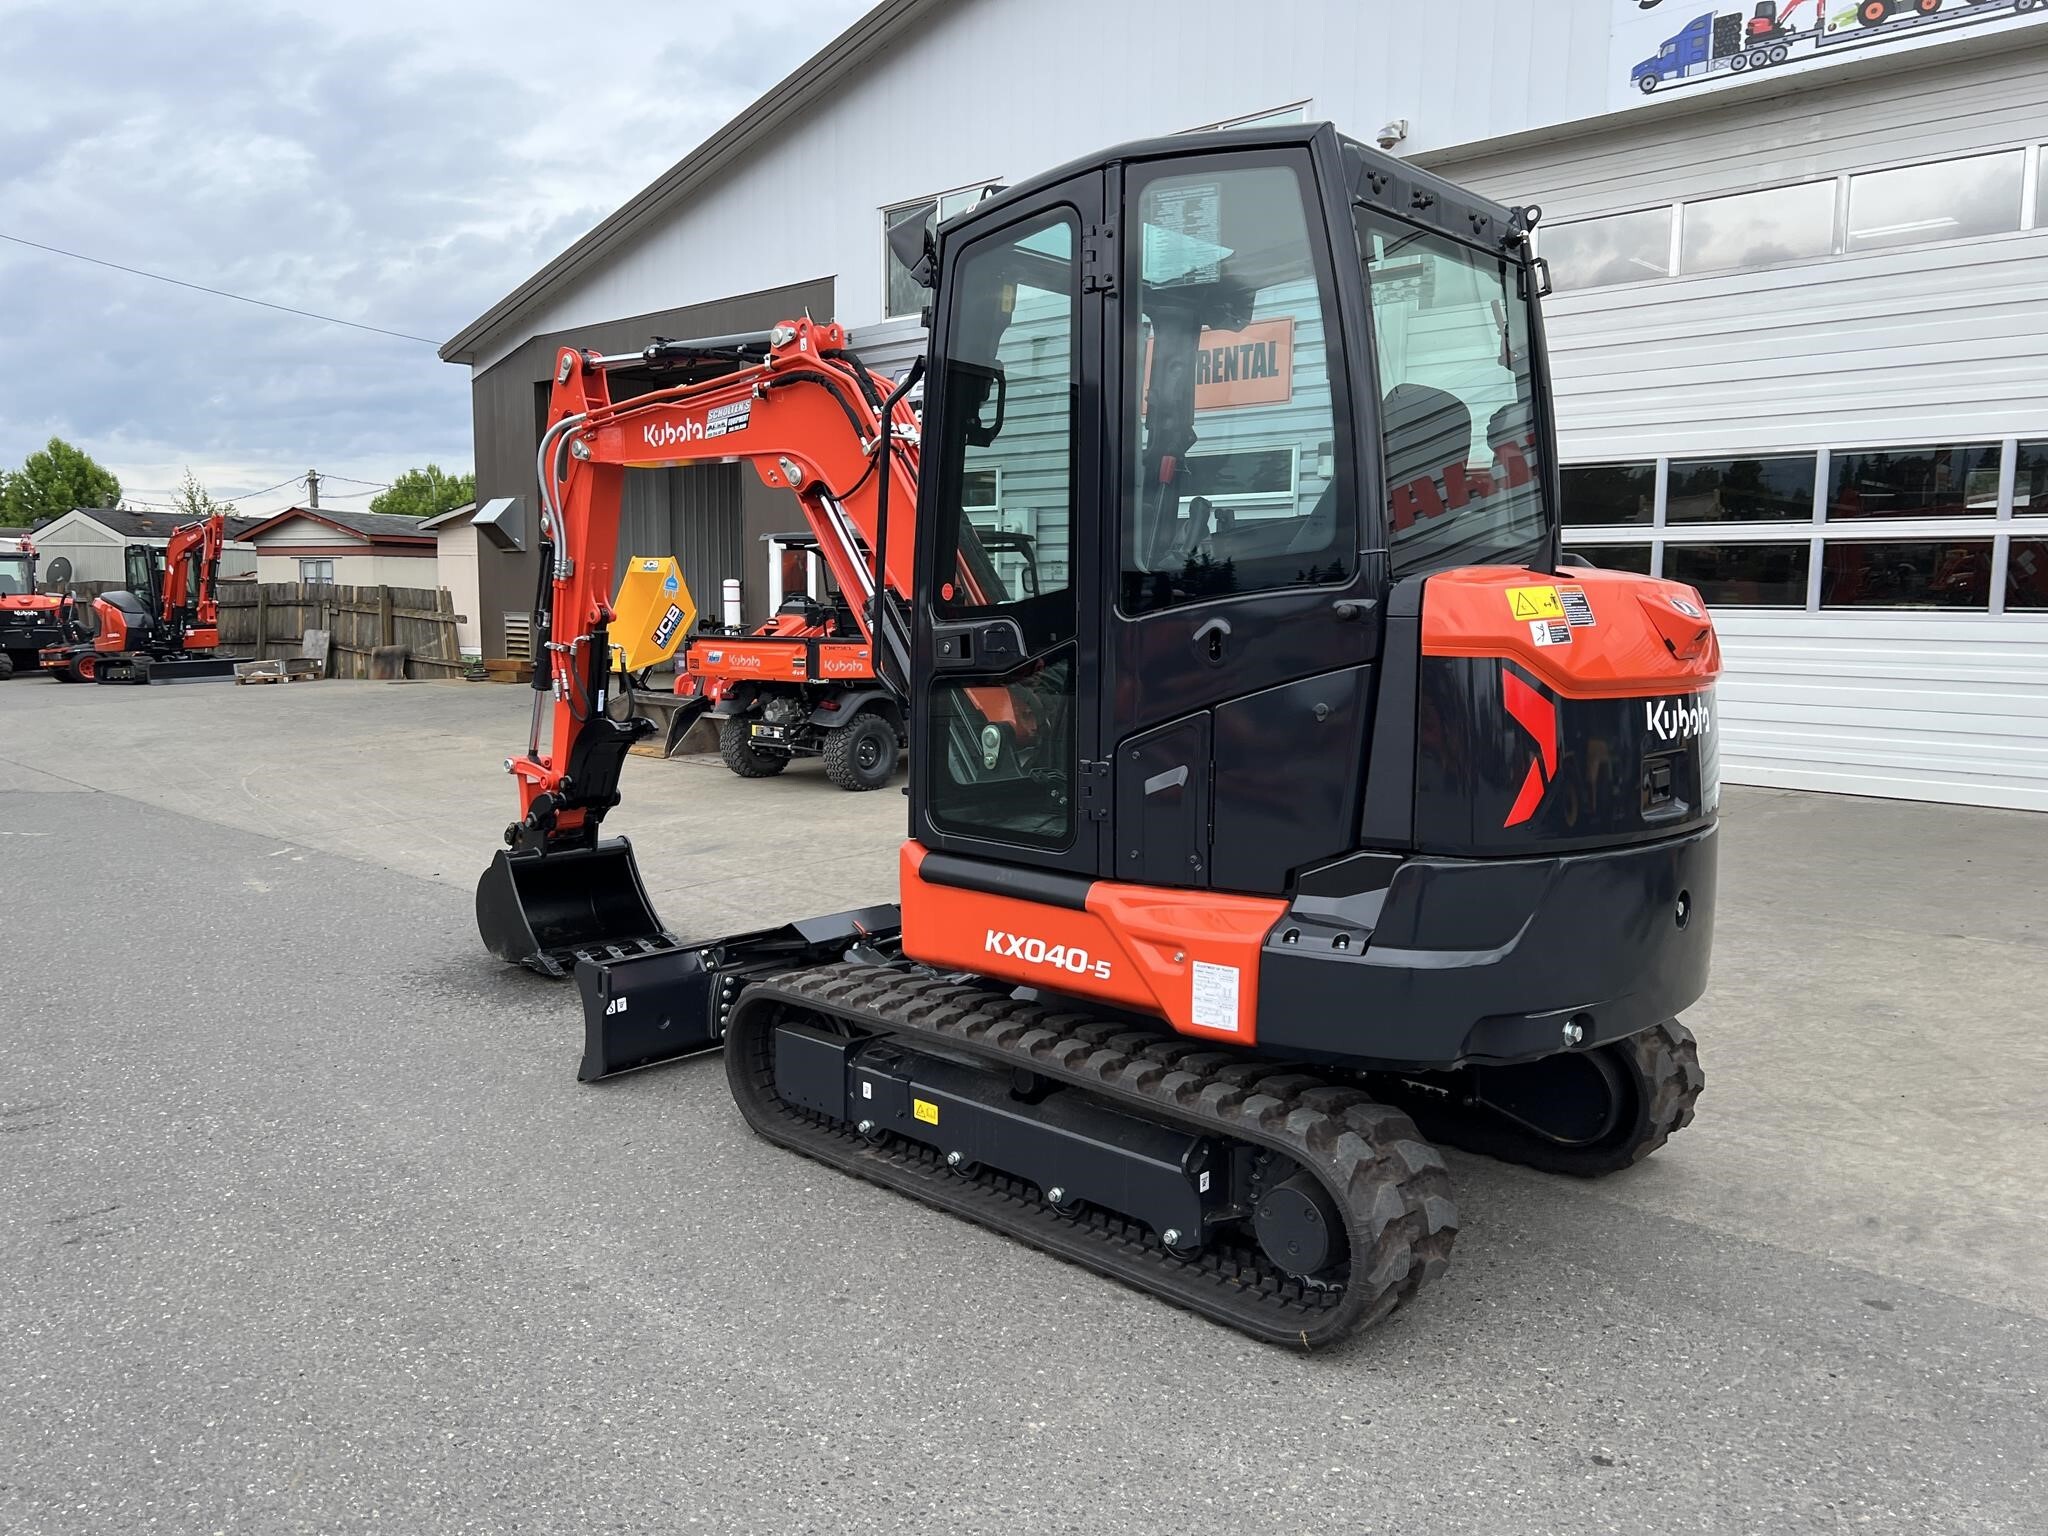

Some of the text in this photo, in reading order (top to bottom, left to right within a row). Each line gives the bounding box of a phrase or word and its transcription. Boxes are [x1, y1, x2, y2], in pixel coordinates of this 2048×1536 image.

[1196, 341, 1279, 385] RENTAL
[643, 417, 703, 447] Kubota
[655, 605, 680, 645] JCB
[729, 655, 760, 667] Kubota
[824, 660, 863, 672] Kubota
[1646, 697, 1710, 740] Kubota
[984, 929, 1112, 980] KX040-5
